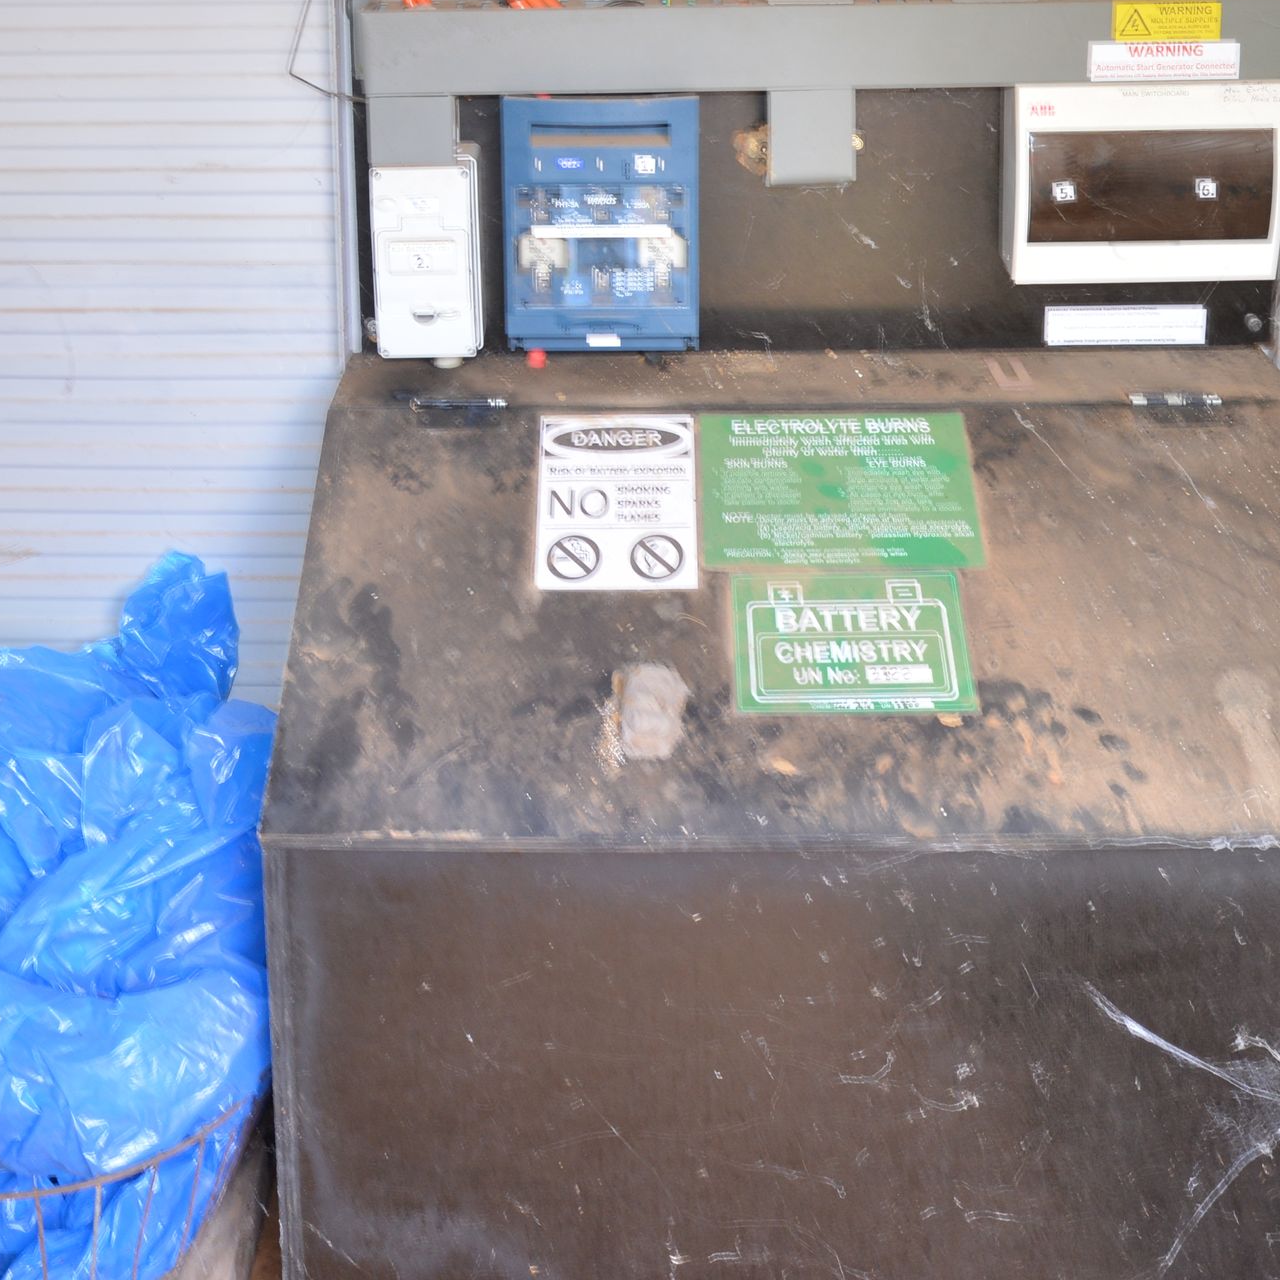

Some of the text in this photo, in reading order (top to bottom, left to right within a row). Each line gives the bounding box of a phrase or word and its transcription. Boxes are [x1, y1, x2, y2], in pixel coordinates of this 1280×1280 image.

[1159, 5, 1213, 15] WARNING
[1185, 16, 1218, 24] SUPPLIES
[1129, 44, 1204, 58] WARNING
[1096, 62, 1236, 72] Automatic Start Generator Connected
[1030, 104, 1056, 116] ABB
[1060, 188, 1073, 199] 5.
[1201, 185, 1215, 197] 6.
[733, 420, 931, 435] ELECTROLYTE BURNS
[572, 432, 663, 447] DANGER
[732, 436, 935, 448] Immediately wash affected area with
[765, 448, 849, 458] plenty of water
[727, 460, 788, 469] SKIN BURNS
[869, 460, 927, 468] EYE BURNS
[617, 486, 671, 495] SMOKING
[549, 489, 609, 518] NO
[617, 500, 661, 509] SPARKS
[776, 607, 921, 632] BATTERY
[776, 641, 928, 664] CHEMISTRY
[794, 667, 861, 685] UN No:
